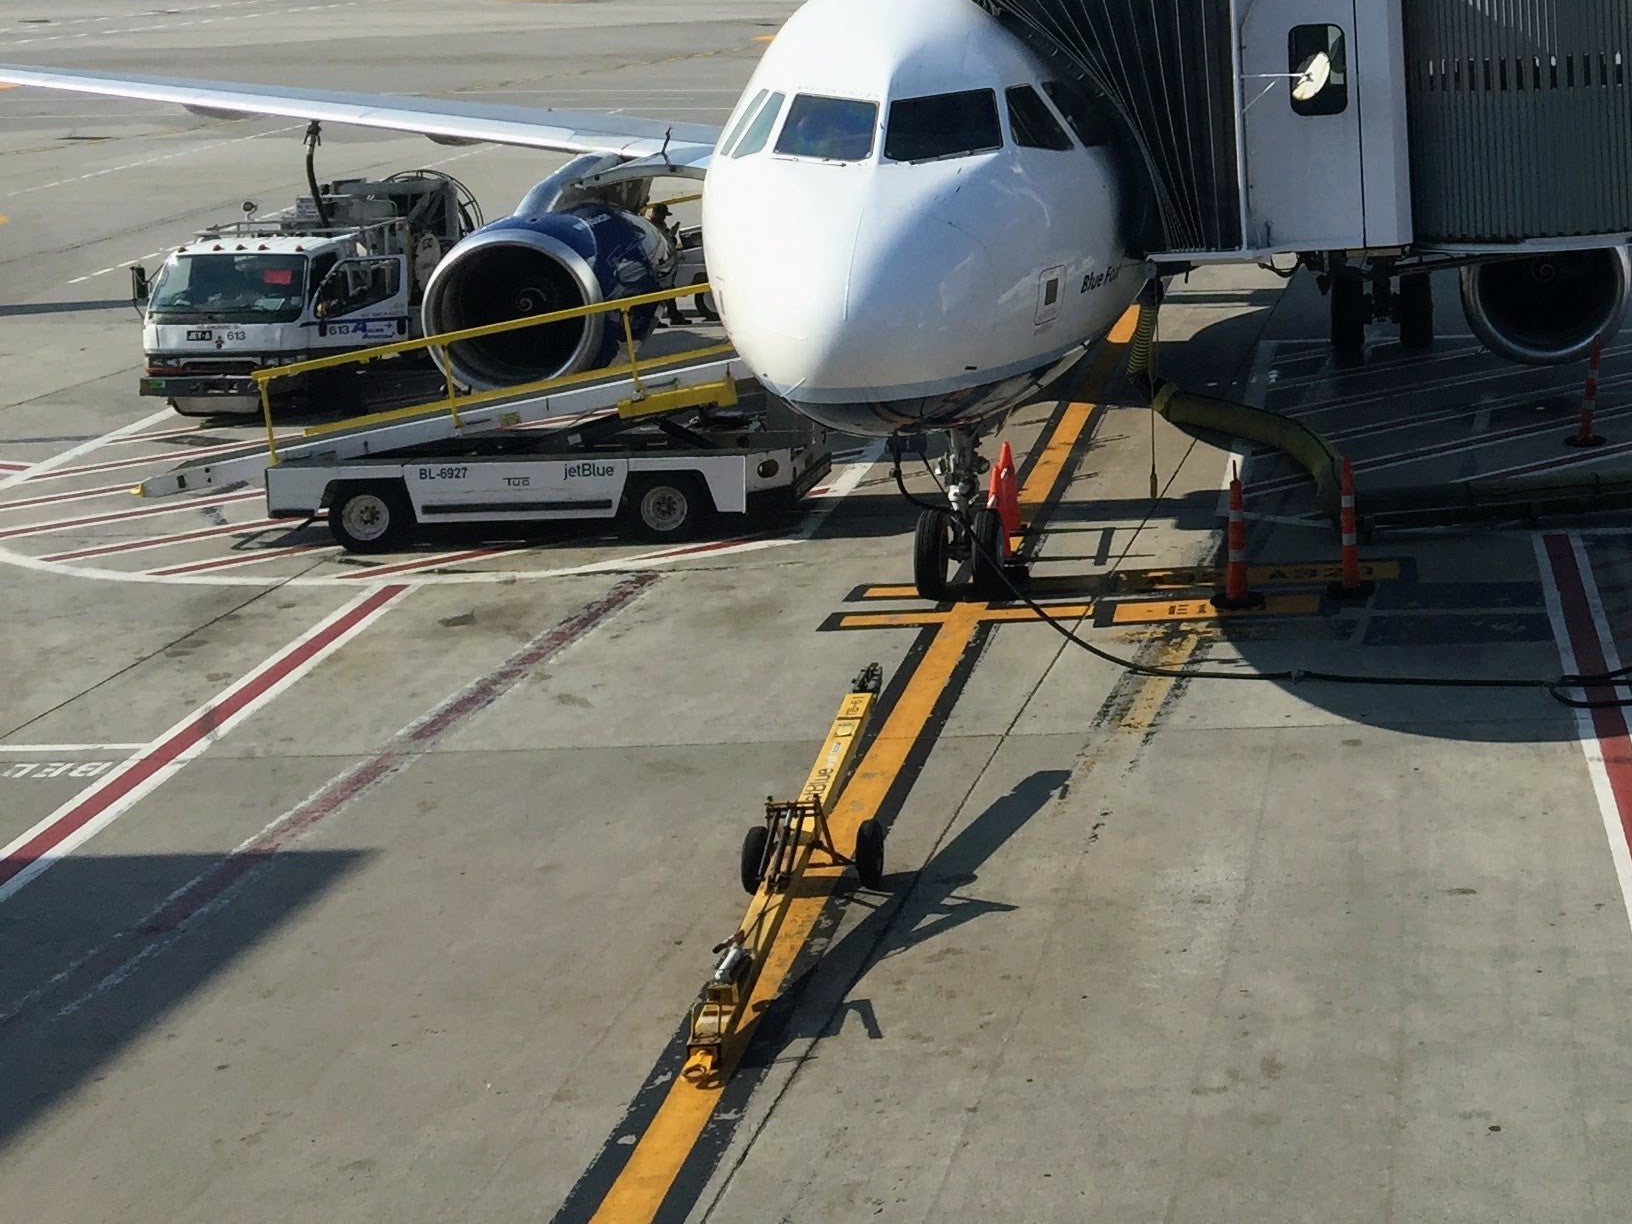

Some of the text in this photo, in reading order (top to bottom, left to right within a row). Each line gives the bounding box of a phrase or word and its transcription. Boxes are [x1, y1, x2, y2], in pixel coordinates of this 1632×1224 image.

[1080, 271, 1104, 294] Blue
[227, 331, 247, 341] 613
[419, 466, 468, 480] BL-6927
[563, 463, 615, 480] jetBlue
